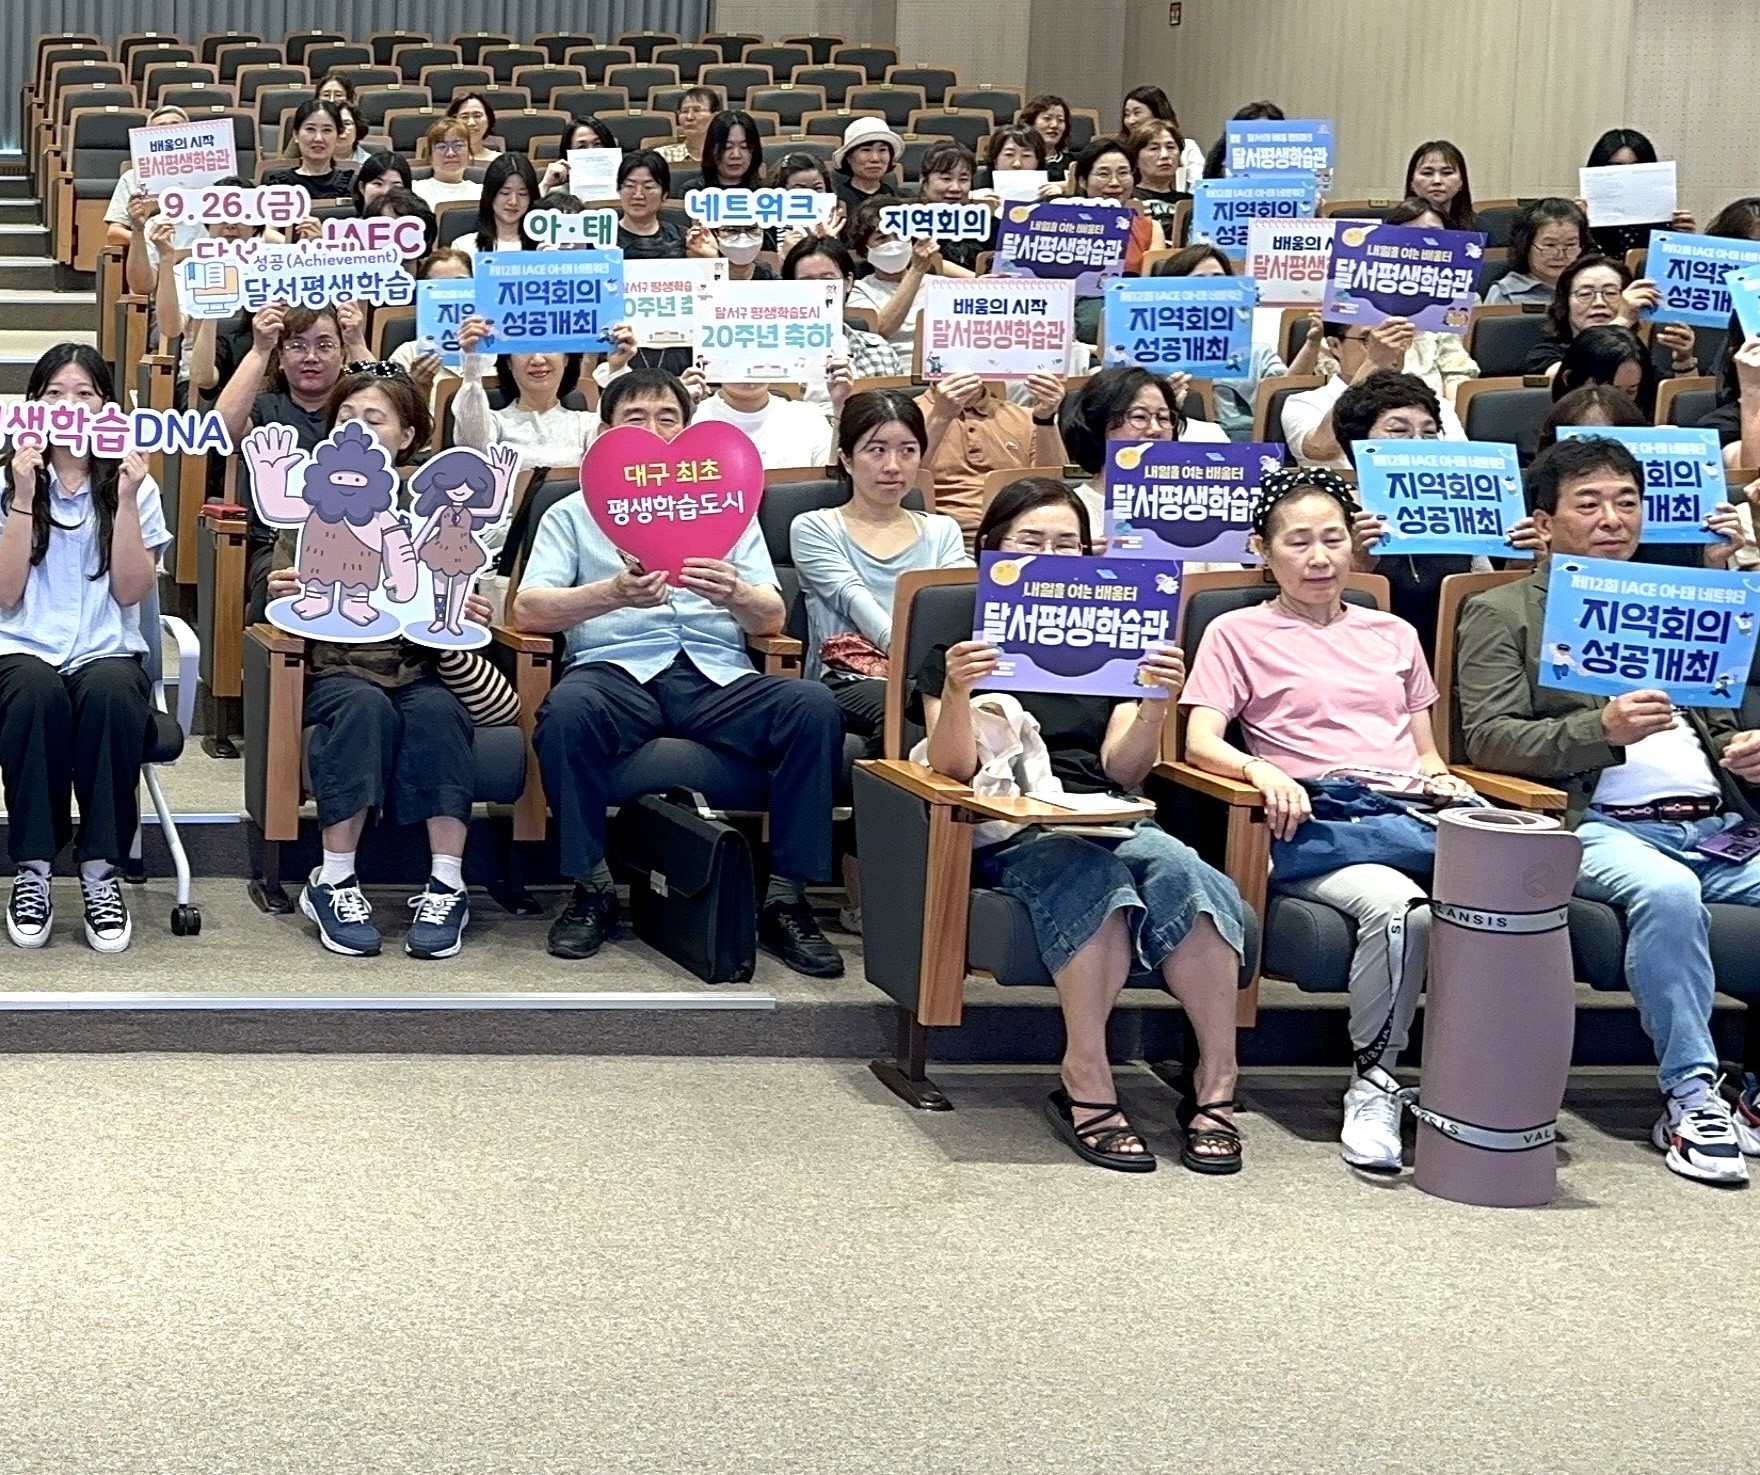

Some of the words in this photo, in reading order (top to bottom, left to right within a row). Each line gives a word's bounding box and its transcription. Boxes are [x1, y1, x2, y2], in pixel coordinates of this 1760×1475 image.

[150, 138, 187, 152] 배움의
[191, 135, 214, 148] 시작
[138, 149, 229, 178] 달서평생학습관
[1232, 146, 1328, 170] 달서평생학습관
[691, 193, 817, 222] 네트워크
[1213, 201, 1297, 221] 지역회의
[885, 210, 986, 236] 지역회의
[1001, 233, 1123, 266] 달서평생학습관
[1273, 236, 1321, 251] 배움의
[245, 271, 411, 306] 달서평생학습
[498, 279, 601, 305] 지역회의
[1333, 258, 1473, 299] 달서평생학습관
[715, 307, 747, 320] 달서구
[750, 306, 820, 320] 평생학습도시
[953, 298, 1007, 315] 배움의
[1012, 298, 1047, 316] 시작
[1129, 306, 1234, 332] 지역회의
[502, 309, 598, 336] 성공개최
[701, 324, 779, 349] 20주년
[785, 323, 834, 348] 축하
[933, 319, 1065, 350] 달서평생학습관
[1133, 336, 1230, 363] 성공개최
[624, 462, 670, 487] 대구
[676, 458, 723, 483] 최초
[1144, 464, 1180, 481] 내일을
[1182, 466, 1204, 481] 여는
[1206, 466, 1244, 481] 배움터
[1637, 459, 1702, 488] 회의
[1386, 472, 1503, 503] 지역회의
[607, 490, 744, 526] 평생학습도시
[1396, 505, 1504, 536] 성공개최
[1024, 581, 1065, 599] 내일을
[1068, 584, 1093, 600] 여는
[1095, 586, 1138, 602] 배움터
[983, 601, 1169, 650] 달서평생학습관
[1579, 598, 1733, 645] 지역회의
[1581, 638, 1720, 684] 성공개최
